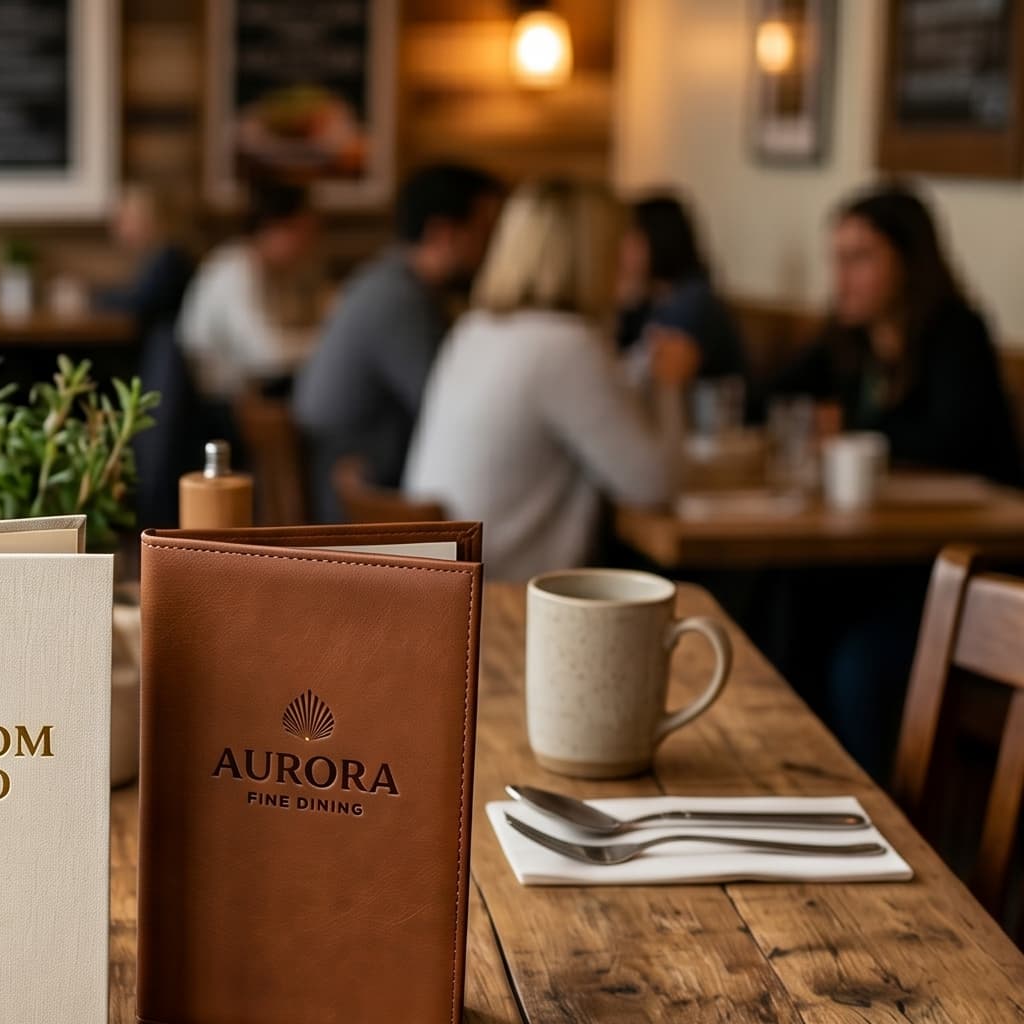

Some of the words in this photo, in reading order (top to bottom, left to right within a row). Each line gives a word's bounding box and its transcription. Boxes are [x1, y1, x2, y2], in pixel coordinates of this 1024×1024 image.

[211, 747, 400, 795] AURORA
[247, 791, 289, 808] FINE
[296, 797, 363, 816] DINING
